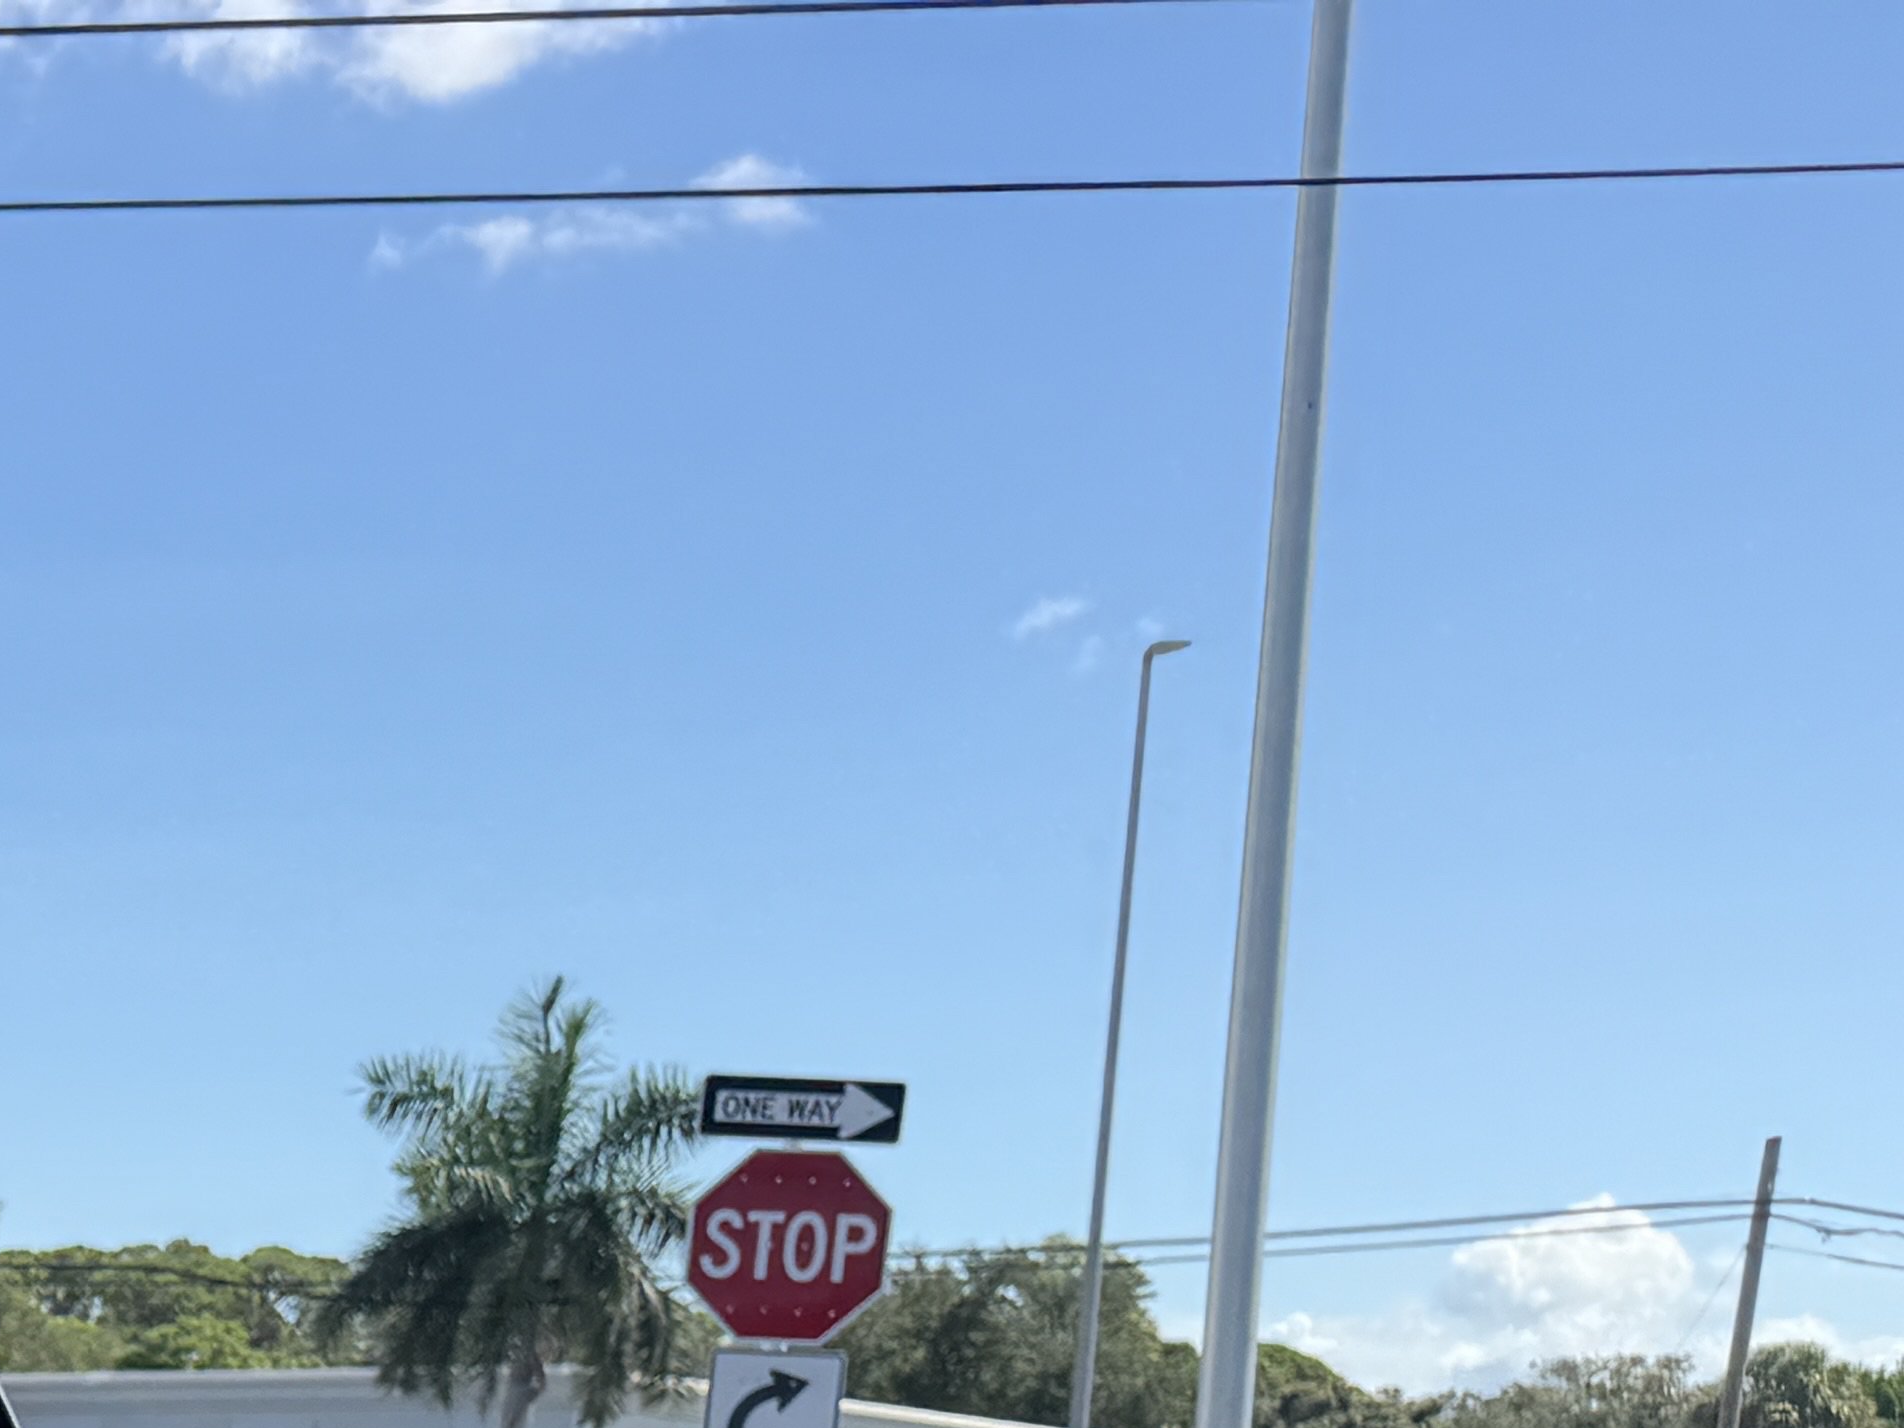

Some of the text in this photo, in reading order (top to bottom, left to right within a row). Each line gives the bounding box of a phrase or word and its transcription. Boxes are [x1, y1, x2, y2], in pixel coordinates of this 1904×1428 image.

[721, 1093, 842, 1126] ONE WAY
[699, 1208, 877, 1284] STOP
